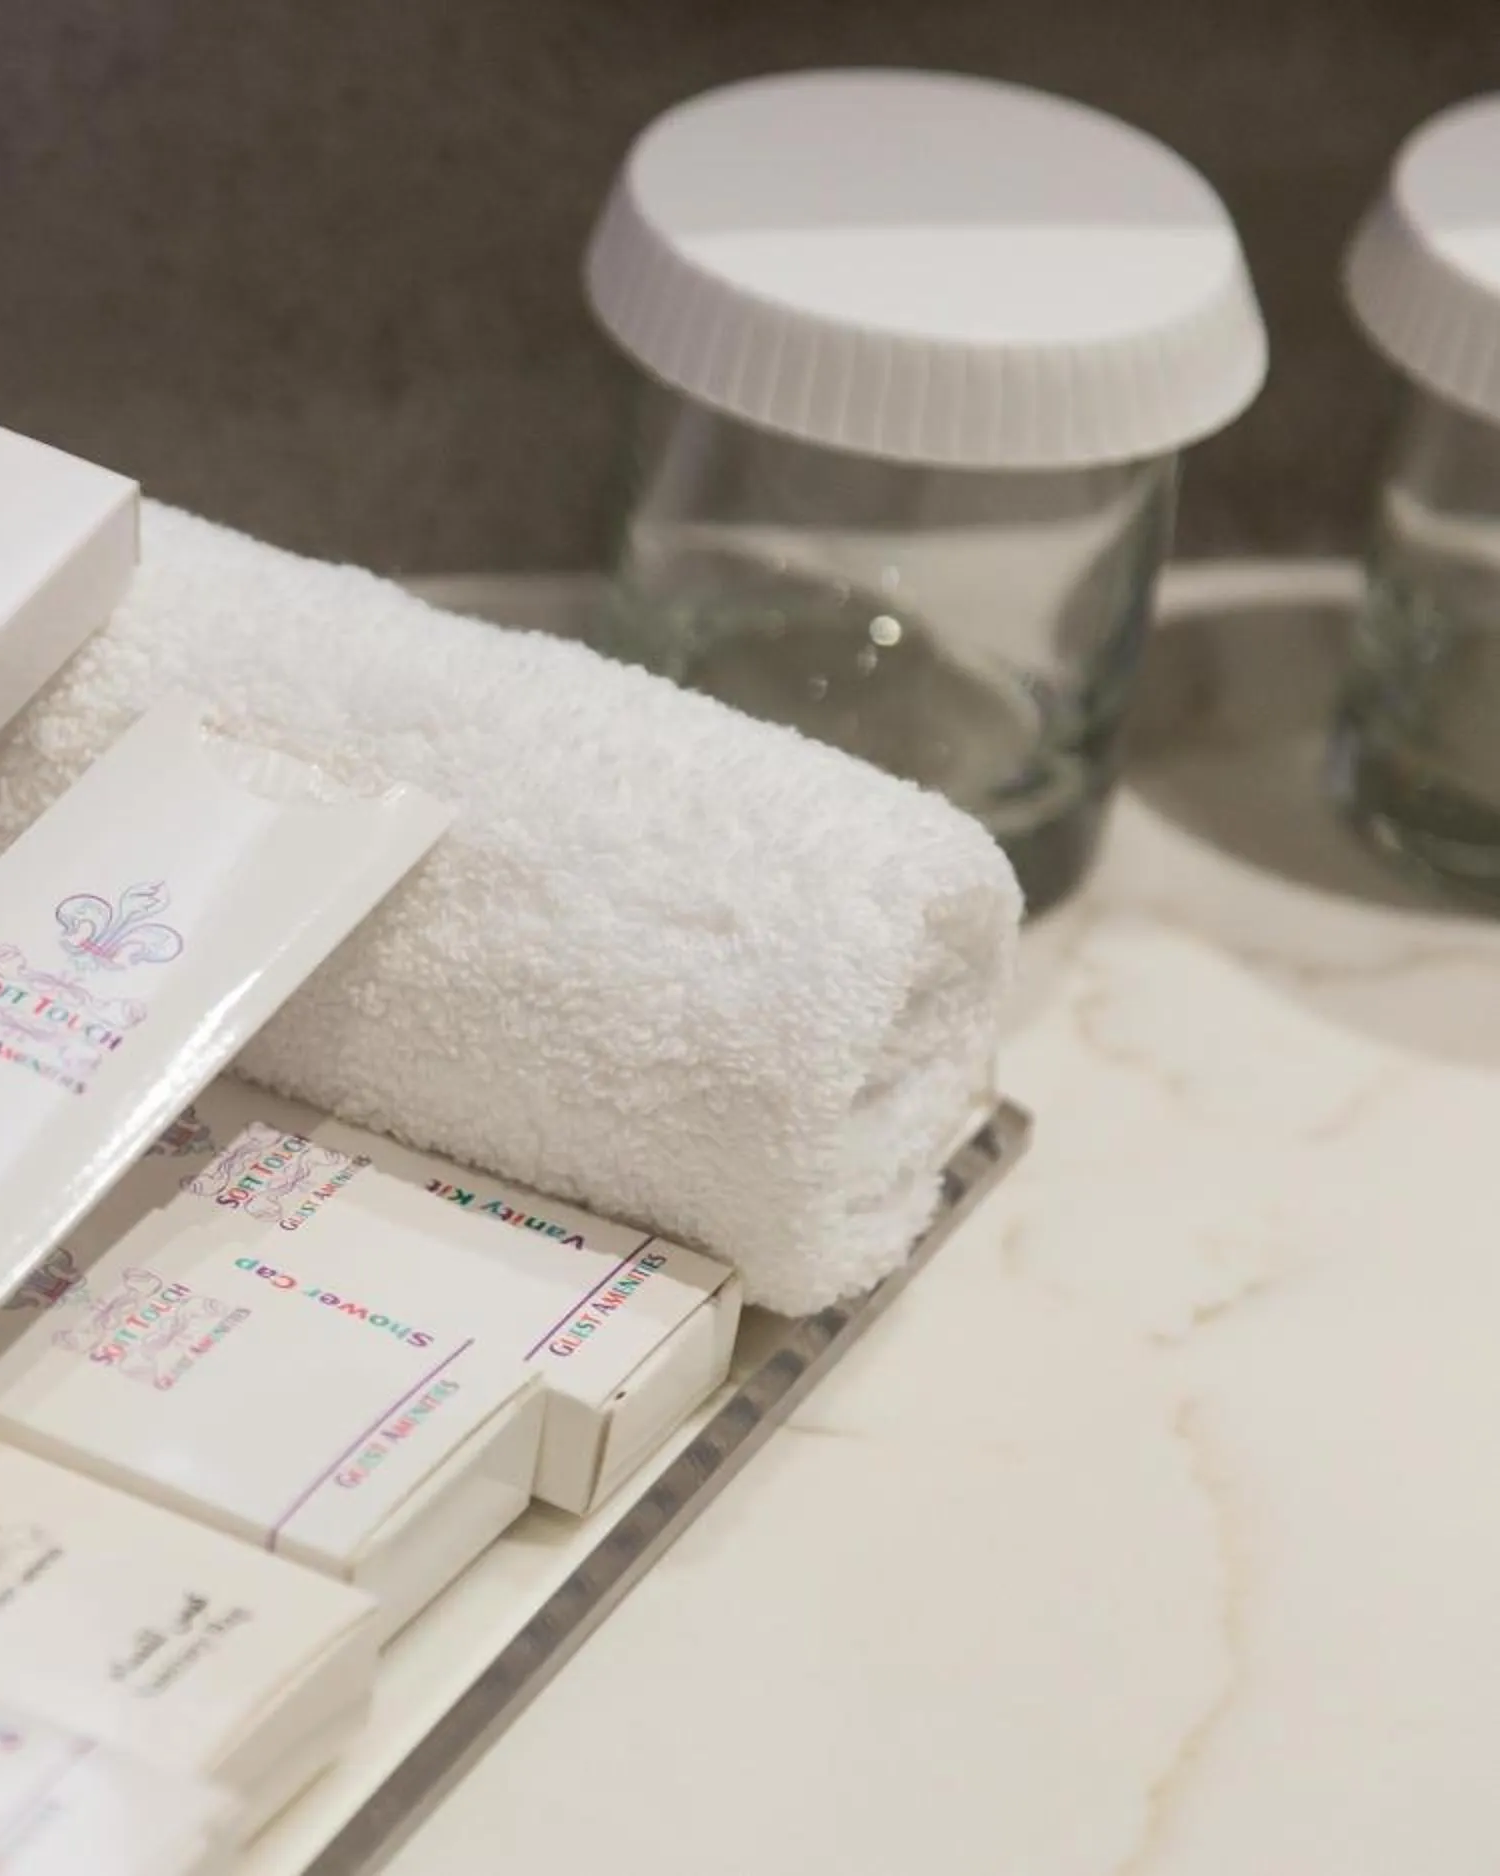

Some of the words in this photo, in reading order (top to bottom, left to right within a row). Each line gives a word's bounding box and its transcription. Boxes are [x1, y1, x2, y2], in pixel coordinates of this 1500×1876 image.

[425, 1178, 475, 1206] Kit
[479, 1200, 586, 1250] Vanity
[234, 1257, 297, 1290] Cap
[302, 1287, 434, 1348] Shower
[549, 1312, 602, 1357] GUEST
[591, 1252, 667, 1316] AMENITIES
